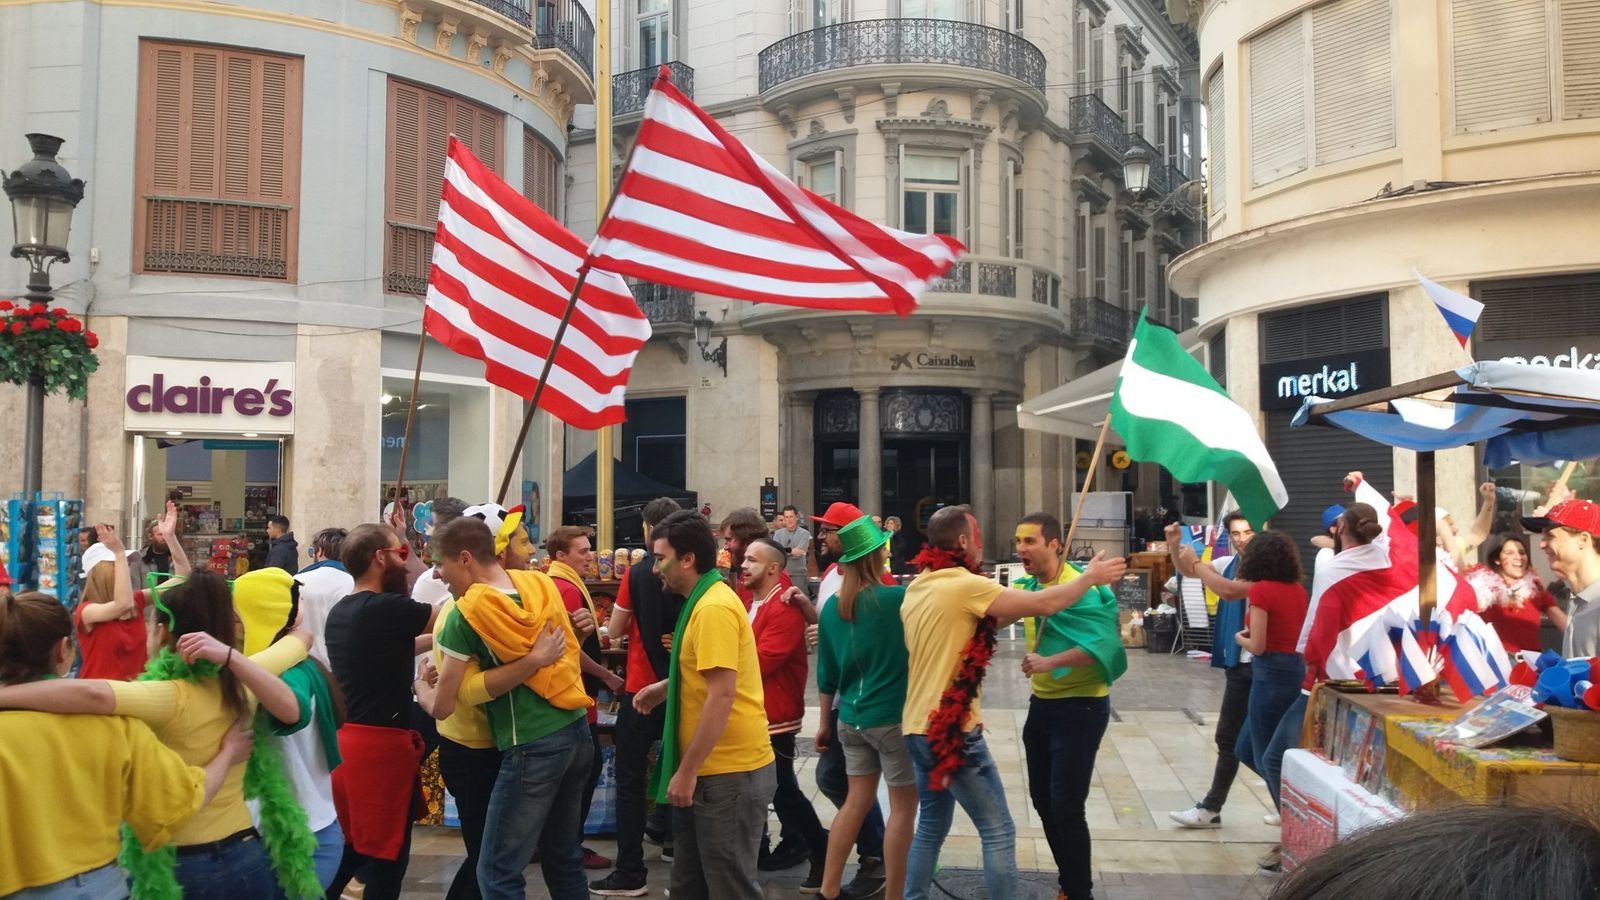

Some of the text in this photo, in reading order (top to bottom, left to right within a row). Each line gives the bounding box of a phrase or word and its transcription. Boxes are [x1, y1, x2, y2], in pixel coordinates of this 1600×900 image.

[916, 352, 976, 368] CaixaBank
[1500, 346, 1600, 370] erk
[126, 373, 293, 417] claire's
[1278, 362, 1358, 398] merkal
